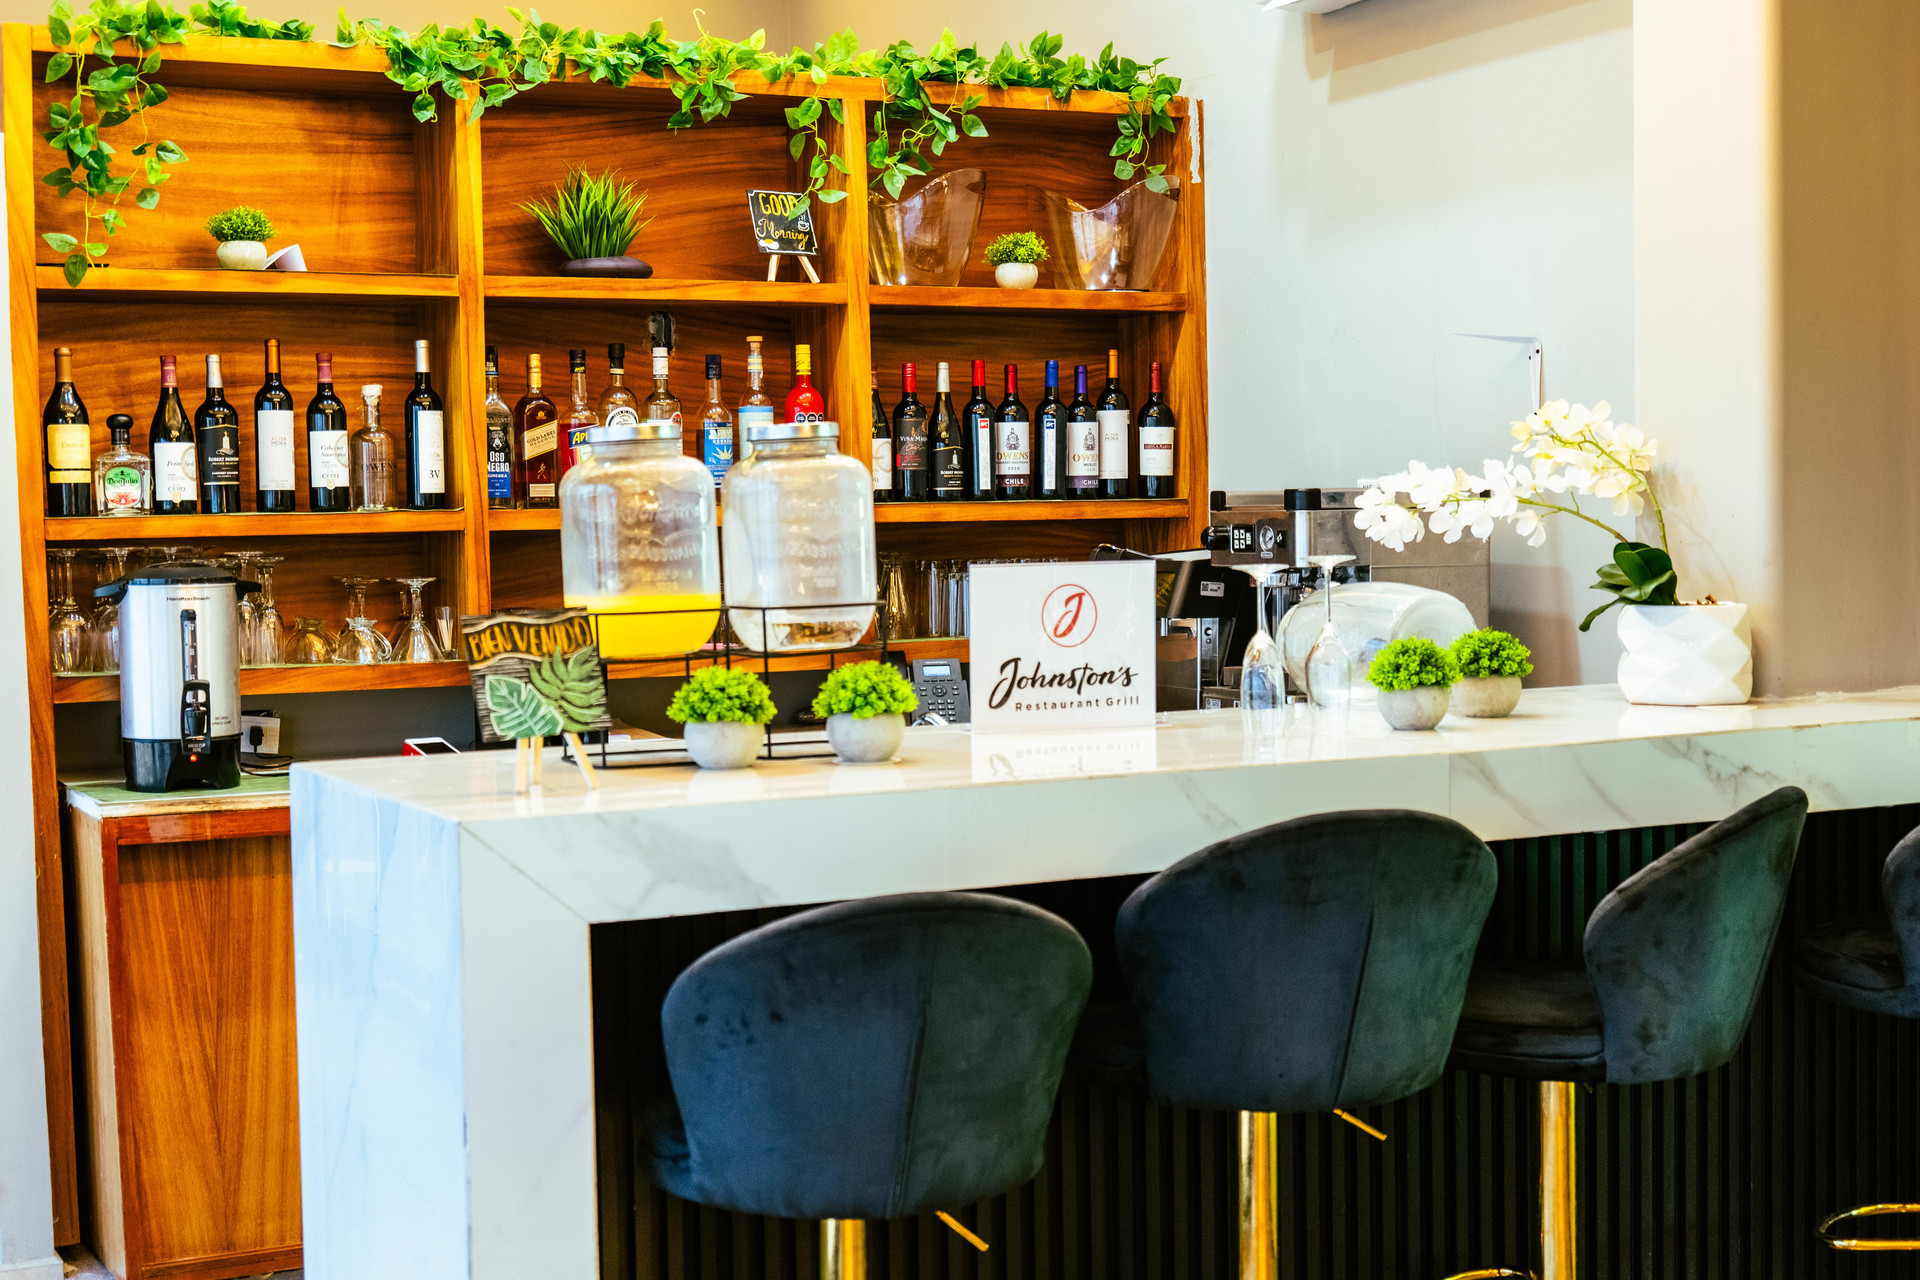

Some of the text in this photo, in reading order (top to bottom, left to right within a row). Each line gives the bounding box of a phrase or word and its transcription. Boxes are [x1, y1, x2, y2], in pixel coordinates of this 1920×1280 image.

[756, 218, 809, 251] Morning
[490, 451, 505, 462] OSO
[997, 452, 1029, 460] OWENS
[429, 470, 440, 479] 3V
[1054, 592, 1086, 638] J
[988, 657, 1139, 710] Johnston's
[1016, 696, 1140, 712] Restaurant Grill
